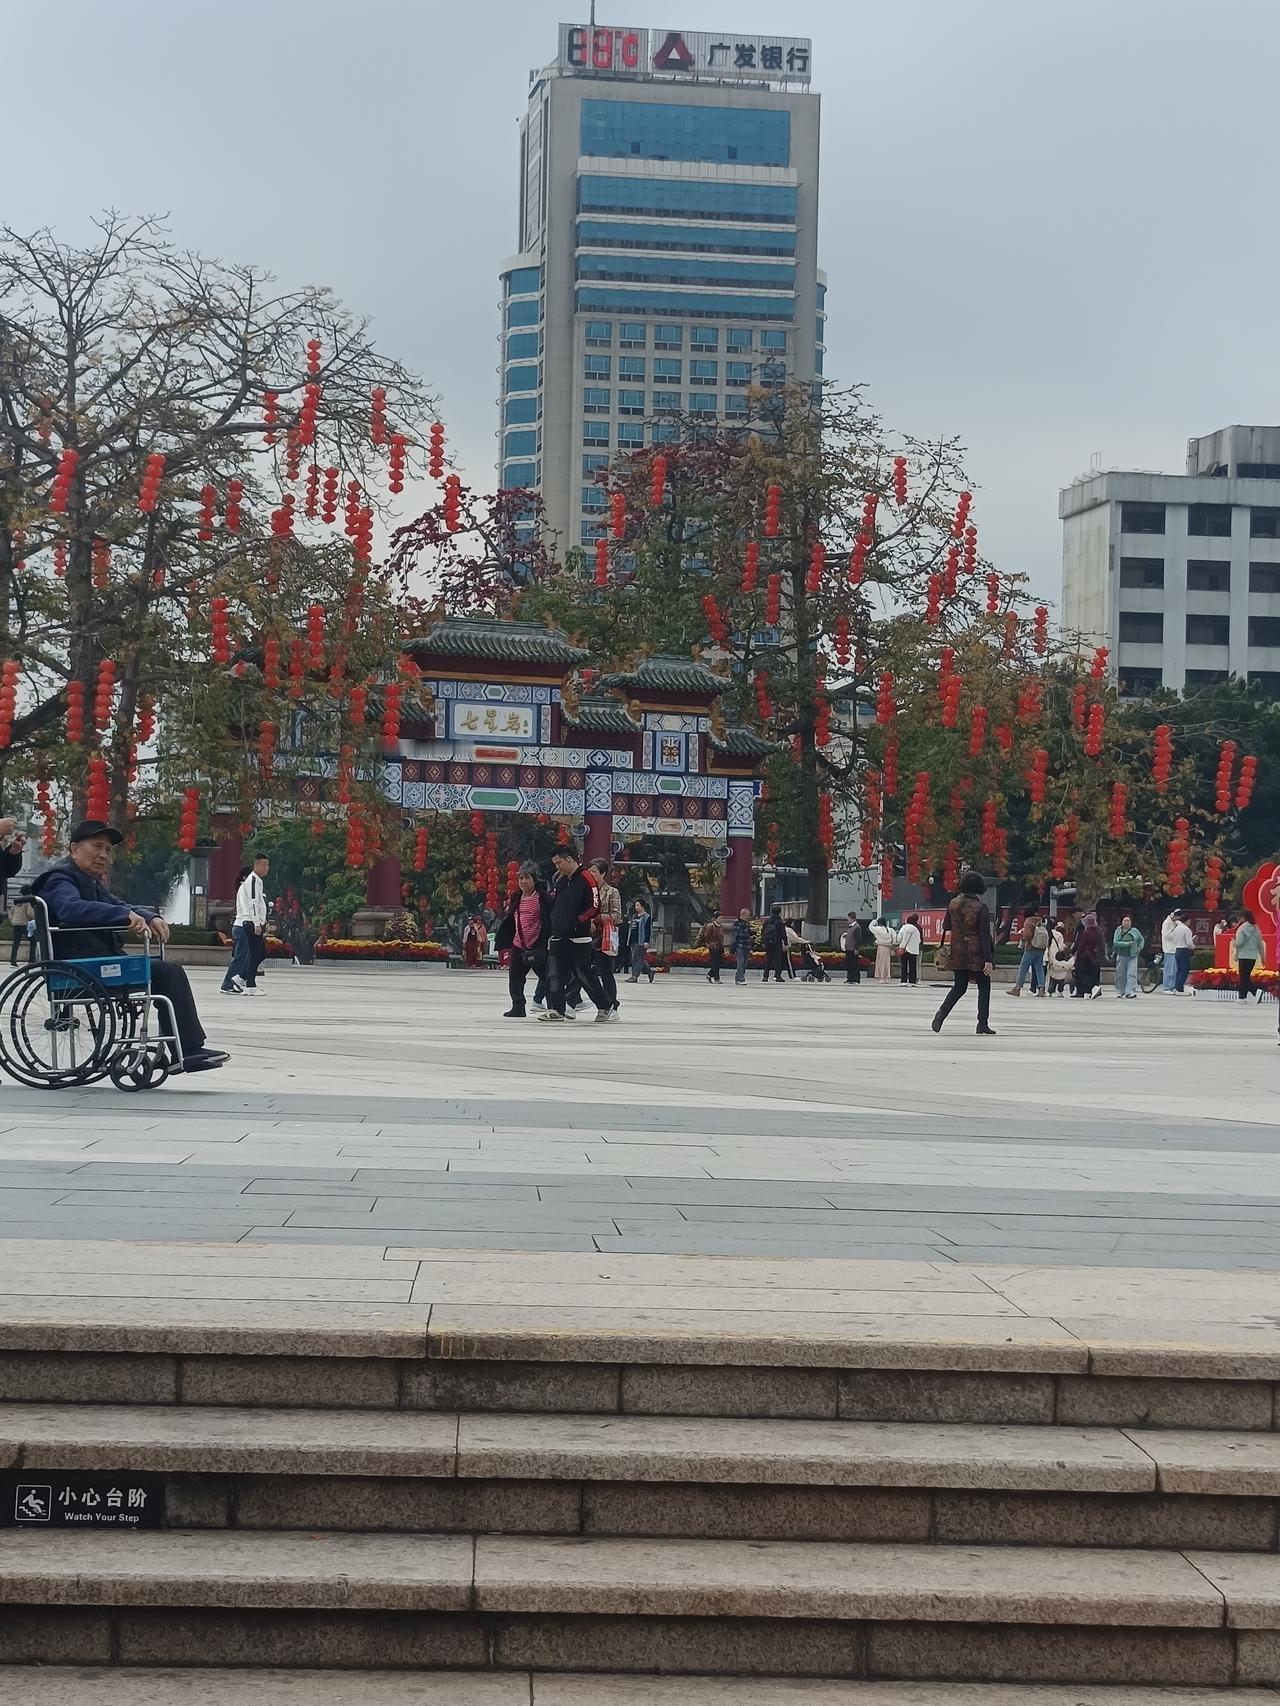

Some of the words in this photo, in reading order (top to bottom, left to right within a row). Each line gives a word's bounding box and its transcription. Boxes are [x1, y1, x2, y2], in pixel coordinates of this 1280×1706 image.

[708, 42, 809, 72] 广发银行
[460, 708, 521, 735] 七星岩
[58, 1486, 147, 1508] 小心台阶
[64, 1512, 93, 1521] Watch
[95, 1512, 117, 1522] Your
[118, 1513, 140, 1523] Step
